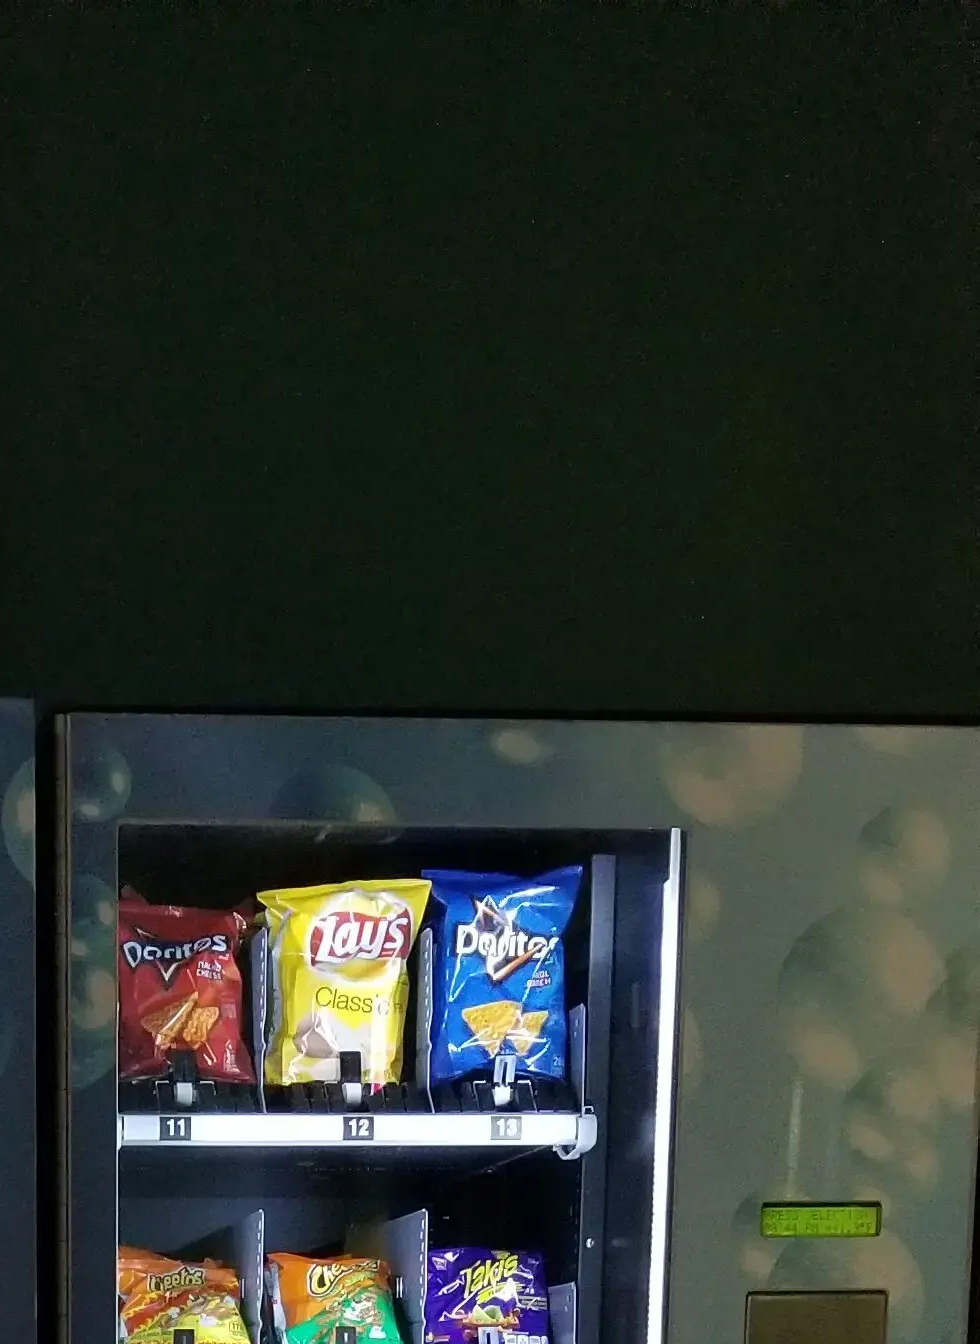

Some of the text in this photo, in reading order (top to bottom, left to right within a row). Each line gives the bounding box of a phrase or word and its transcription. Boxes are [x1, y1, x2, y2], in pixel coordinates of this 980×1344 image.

[123, 934, 227, 968] Doritos
[313, 914, 410, 964] Lay's
[315, 986, 390, 1016] Classc
[166, 1119, 186, 1137] 11
[348, 1119, 370, 1136] 12
[496, 1118, 517, 1136] 13
[461, 1255, 519, 1299] Takis
